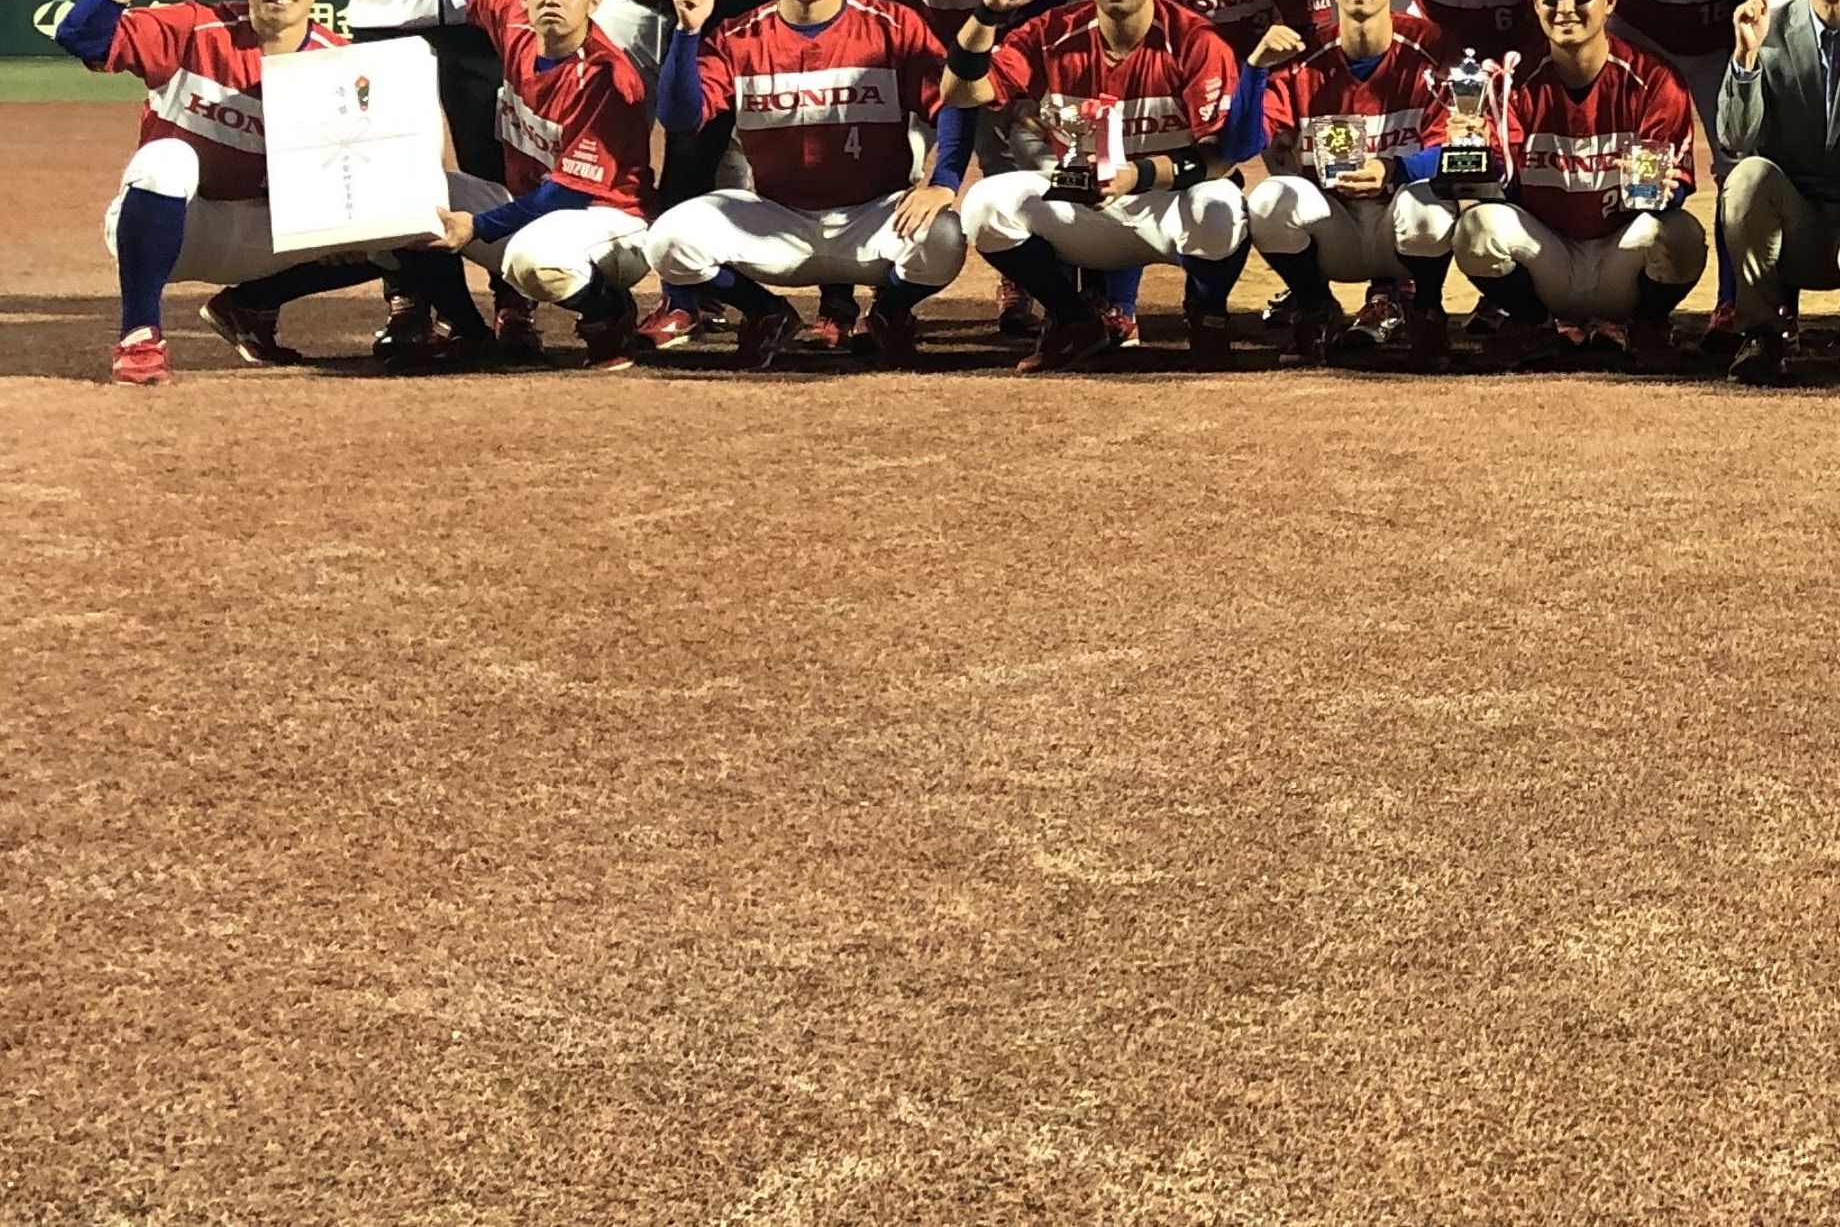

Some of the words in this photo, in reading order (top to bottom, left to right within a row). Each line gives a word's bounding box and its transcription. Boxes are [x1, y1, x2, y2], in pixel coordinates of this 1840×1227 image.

[185, 92, 264, 137] HON
[742, 85, 884, 113] HONDA
[844, 127, 862, 159] 4
